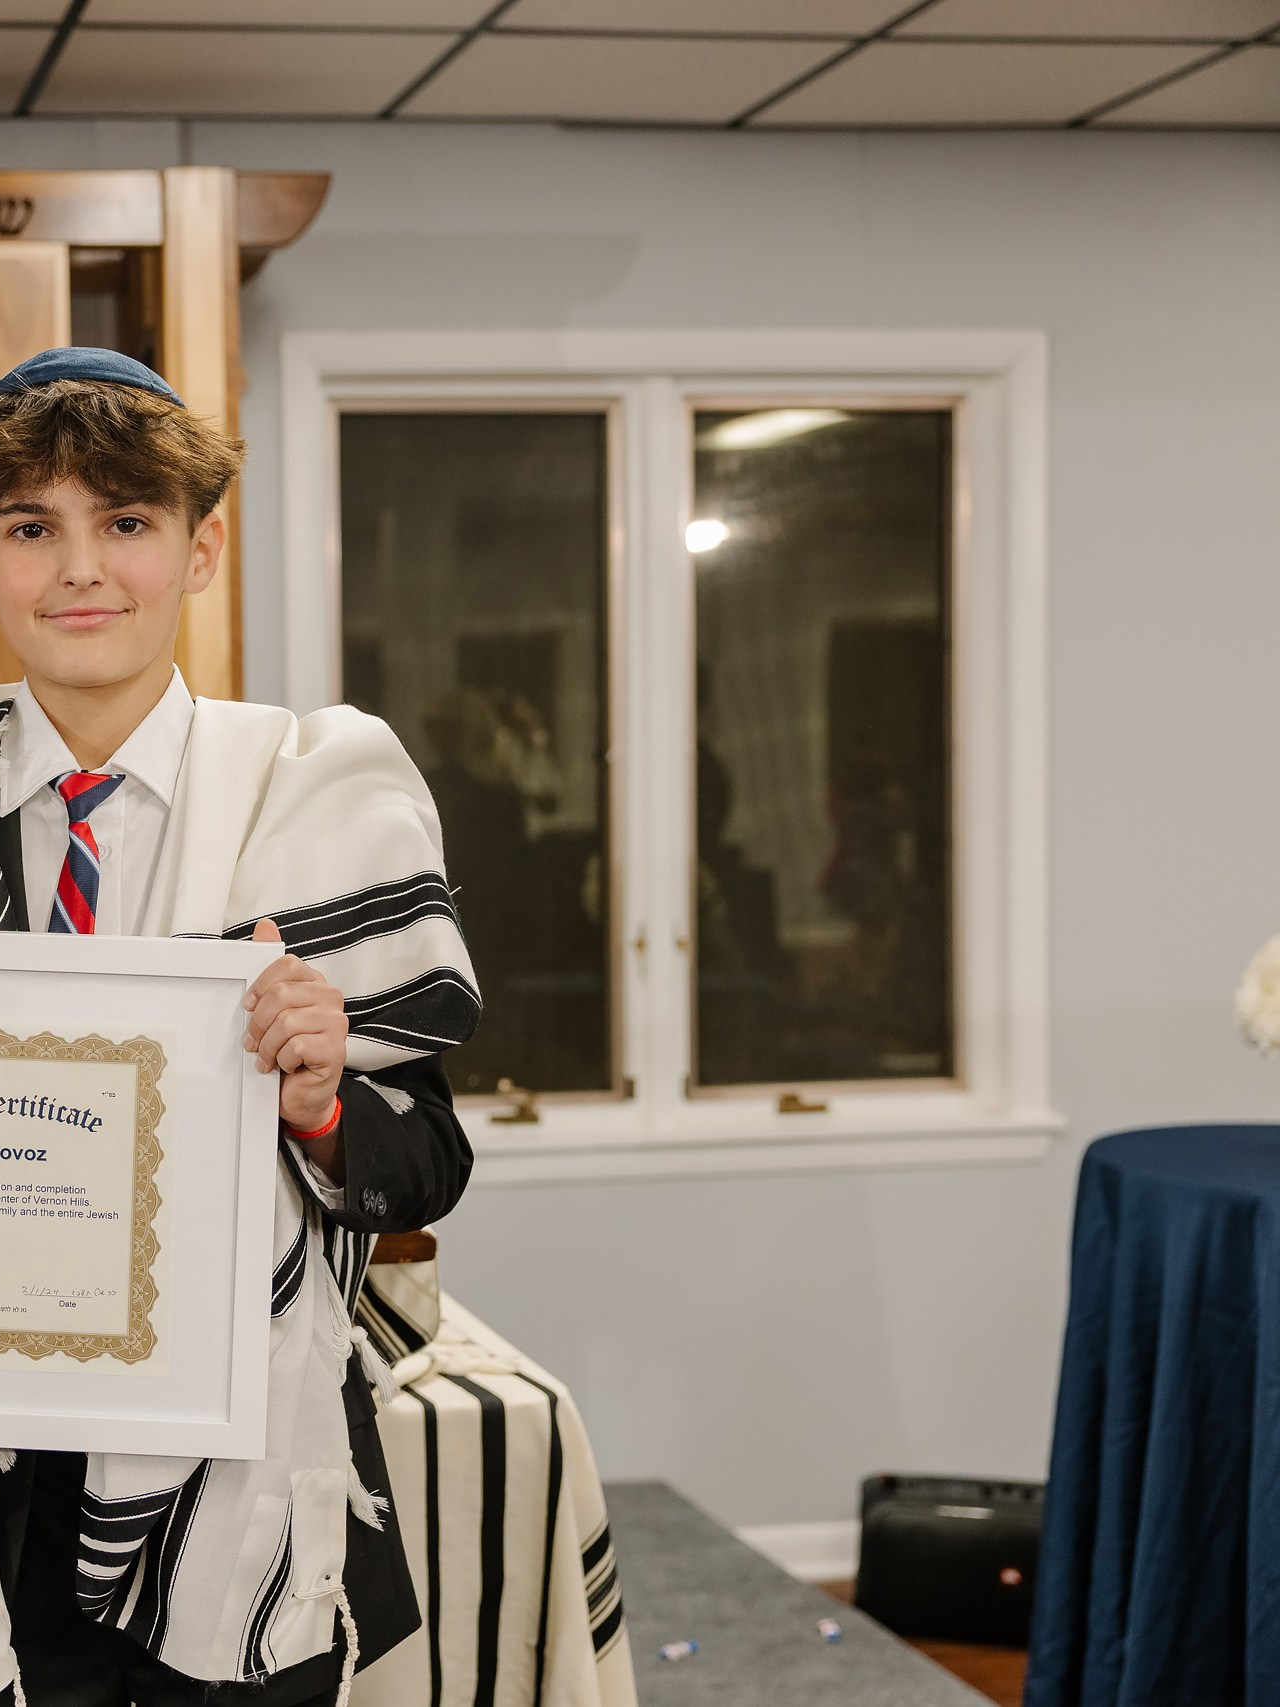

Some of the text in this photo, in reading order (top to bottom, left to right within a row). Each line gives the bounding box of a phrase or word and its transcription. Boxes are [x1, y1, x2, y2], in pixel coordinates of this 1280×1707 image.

[15, 1184, 32, 1192] and
[36, 1185, 86, 1195] completion
[22, 1195, 31, 1204] of
[33, 1196, 67, 1205] Vernon
[70, 1197, 92, 1207] Hills.
[20, 1208, 37, 1216] and
[40, 1208, 54, 1217] the
[58, 1209, 83, 1218] entire
[86, 1210, 118, 1219] Jewish
[59, 1300, 76, 1308] Date
